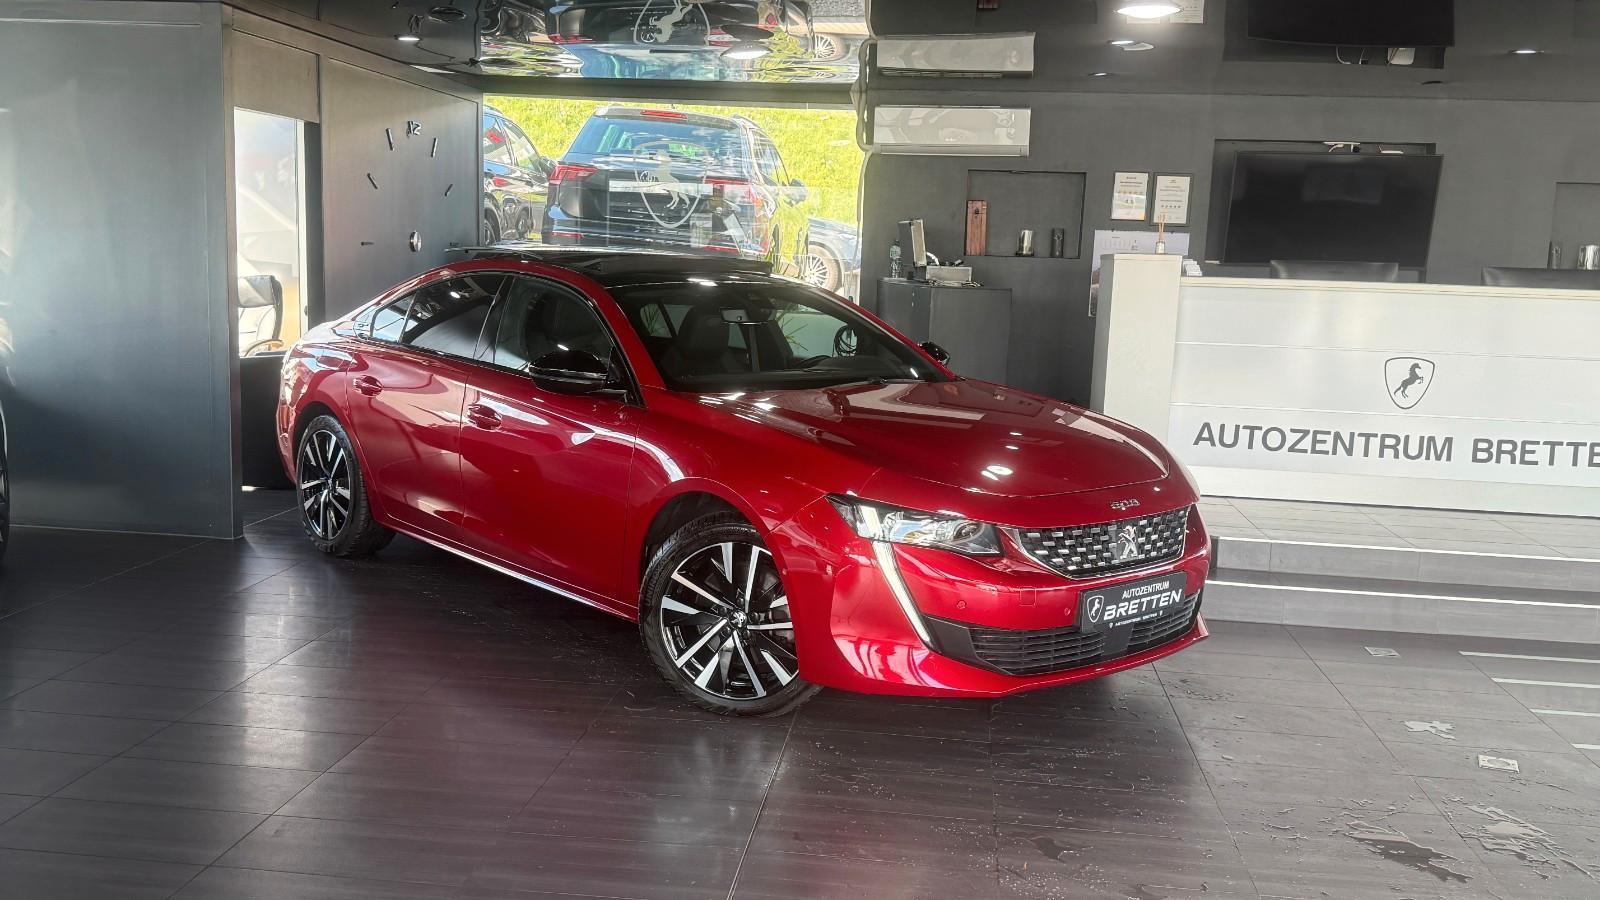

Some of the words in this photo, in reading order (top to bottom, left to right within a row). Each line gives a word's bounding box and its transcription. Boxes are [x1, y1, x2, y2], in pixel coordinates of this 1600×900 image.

[1193, 421, 1454, 462] AUTOZENTRUM
[1103, 588, 1183, 621] BRETTEN
[1121, 580, 1170, 600] AUTOZENTRUM
